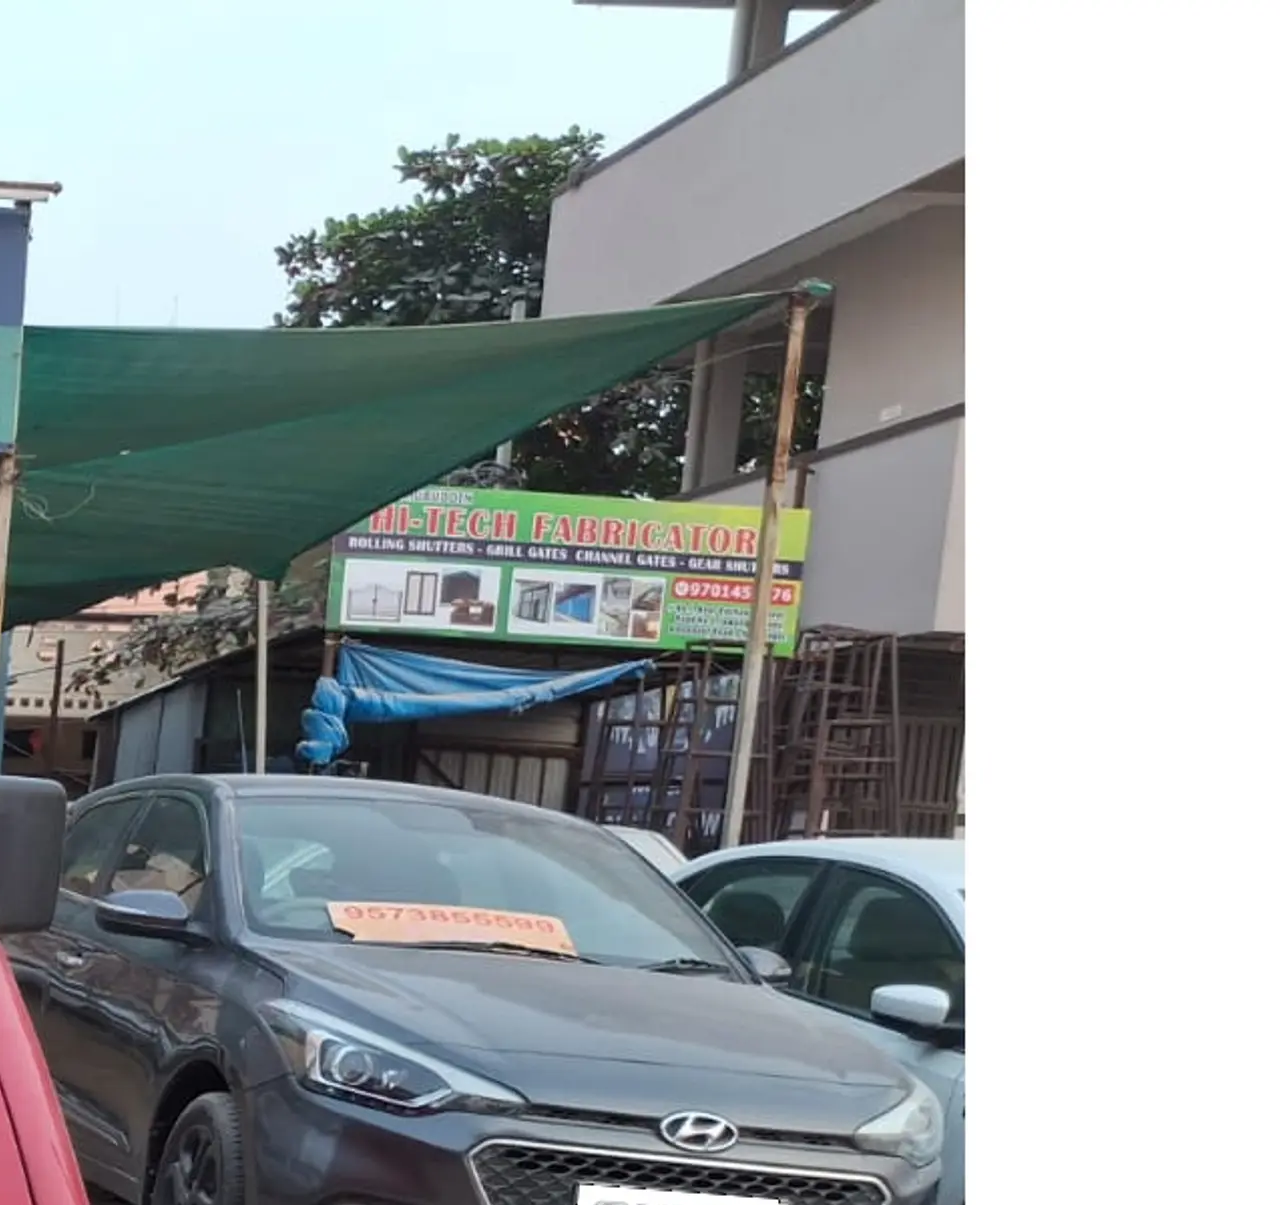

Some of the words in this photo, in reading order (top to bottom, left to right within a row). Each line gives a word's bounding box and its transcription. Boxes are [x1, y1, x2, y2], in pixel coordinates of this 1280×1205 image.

[369, 503, 519, 541] HI-TECH
[348, 536, 404, 551] ROLLING
[408, 538, 474, 555] SHUTTERS
[486, 543, 522, 558] GRILL
[528, 547, 568, 561] GATES
[575, 550, 632, 565] CHANNEL
[637, 555, 676, 569] GATES
[689, 558, 721, 571] GEAR
[689, 581, 793, 602] 97014576
[344, 906, 554, 934] 9573855599
